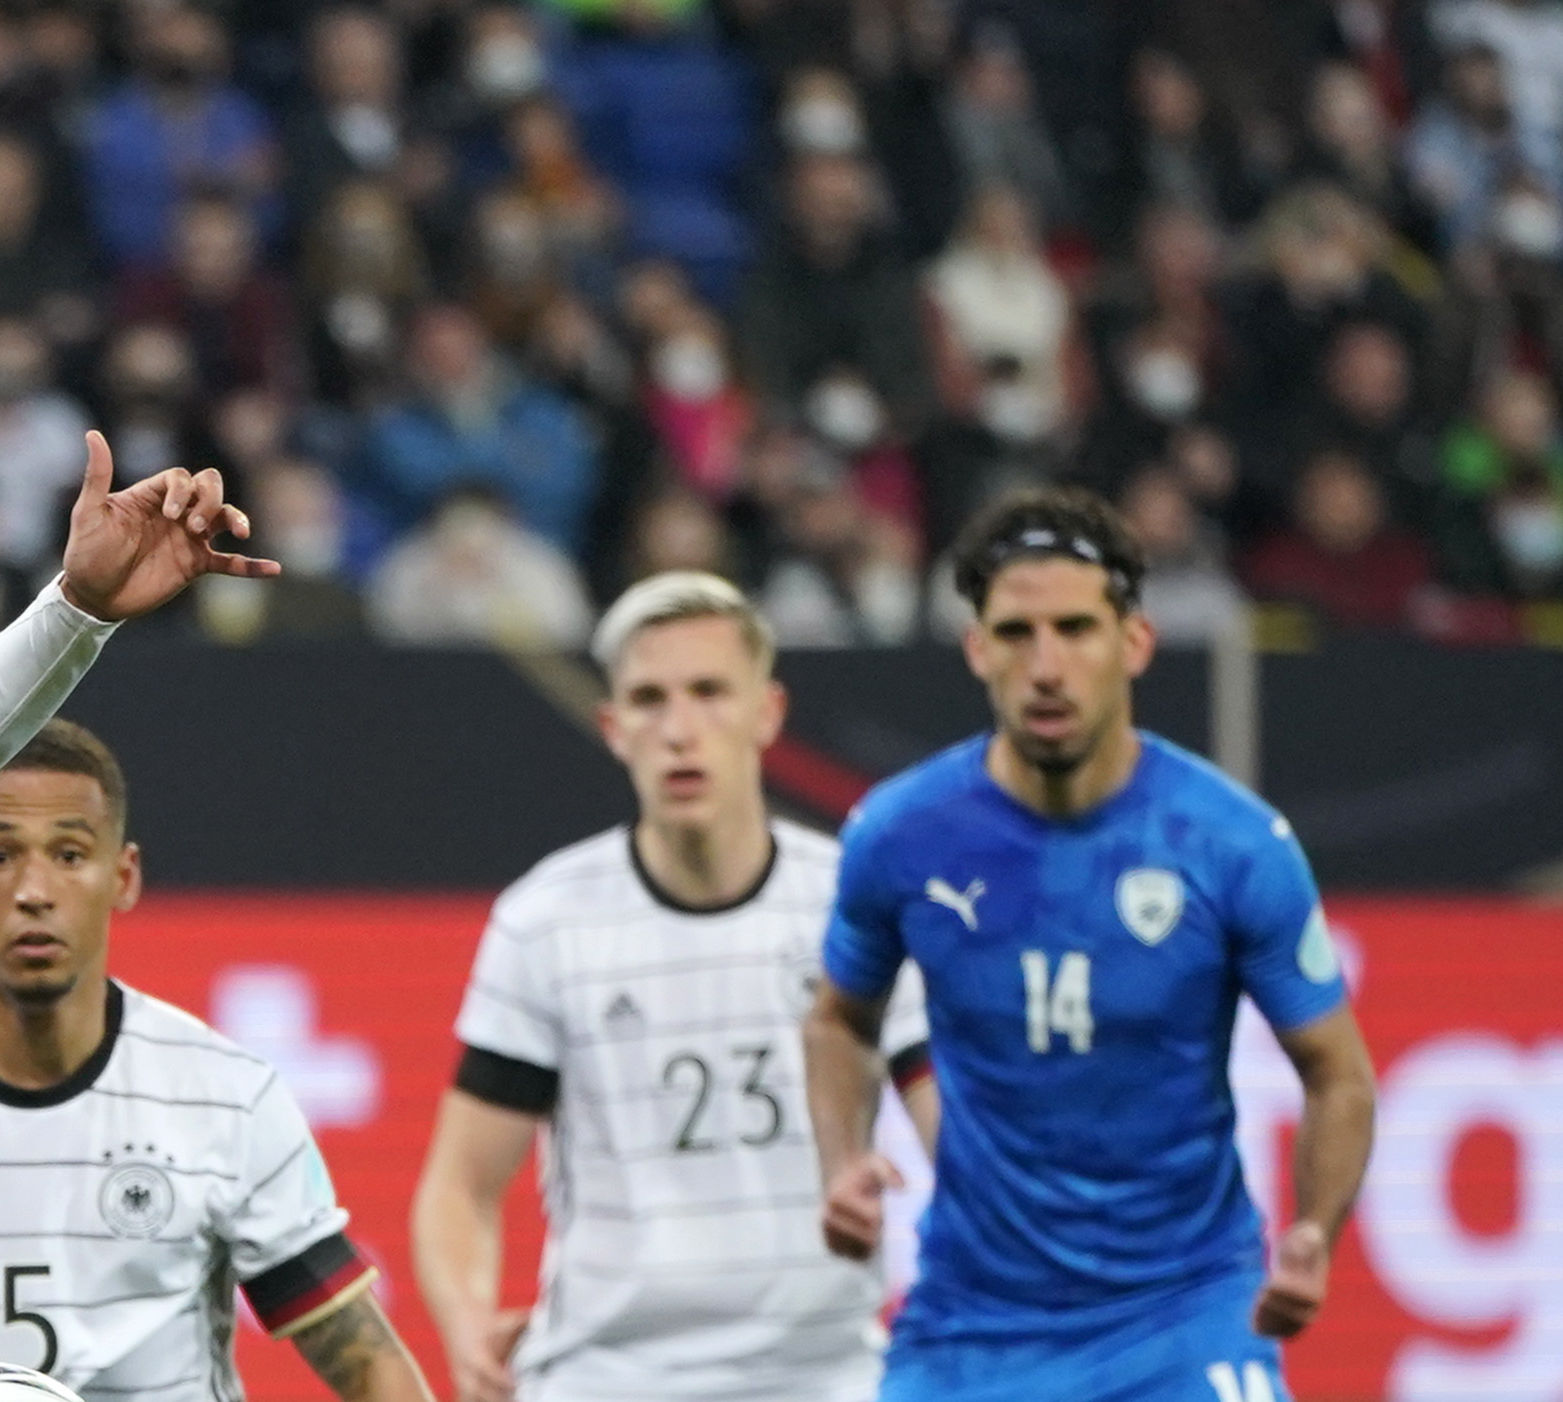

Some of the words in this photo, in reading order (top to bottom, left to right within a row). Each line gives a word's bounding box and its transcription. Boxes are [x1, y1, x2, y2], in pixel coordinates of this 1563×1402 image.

[1020, 950, 1093, 1055] 14
[664, 1045, 783, 1152] 23
[4, 1265, 58, 1374] 5
